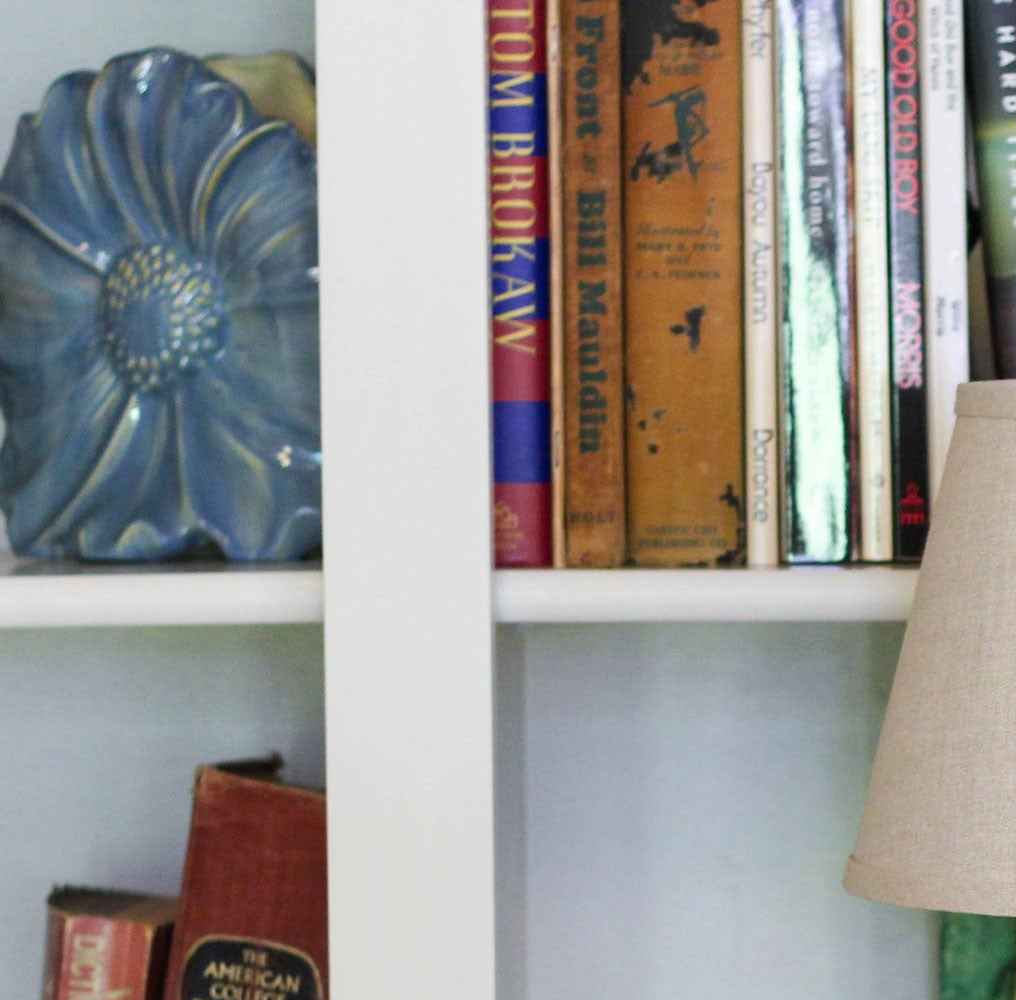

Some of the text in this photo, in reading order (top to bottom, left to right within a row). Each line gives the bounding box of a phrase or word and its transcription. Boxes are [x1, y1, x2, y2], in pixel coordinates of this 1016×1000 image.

[576, 16, 606, 139] Front
[806, 81, 830, 166] toward
[893, 95, 919, 152] OLD
[491, 4, 537, 355] TOM BROKAW
[746, 161, 775, 226] Bayou
[808, 176, 831, 238] home
[894, 159, 919, 215] BOY
[577, 191, 608, 267] Bill
[752, 239, 774, 325] Autumn
[579, 281, 609, 454] Mauldin
[895, 281, 923, 389] MORRIS
[752, 429, 775, 523] Dorrance
[204, 961, 301, 993] AMERICAN
